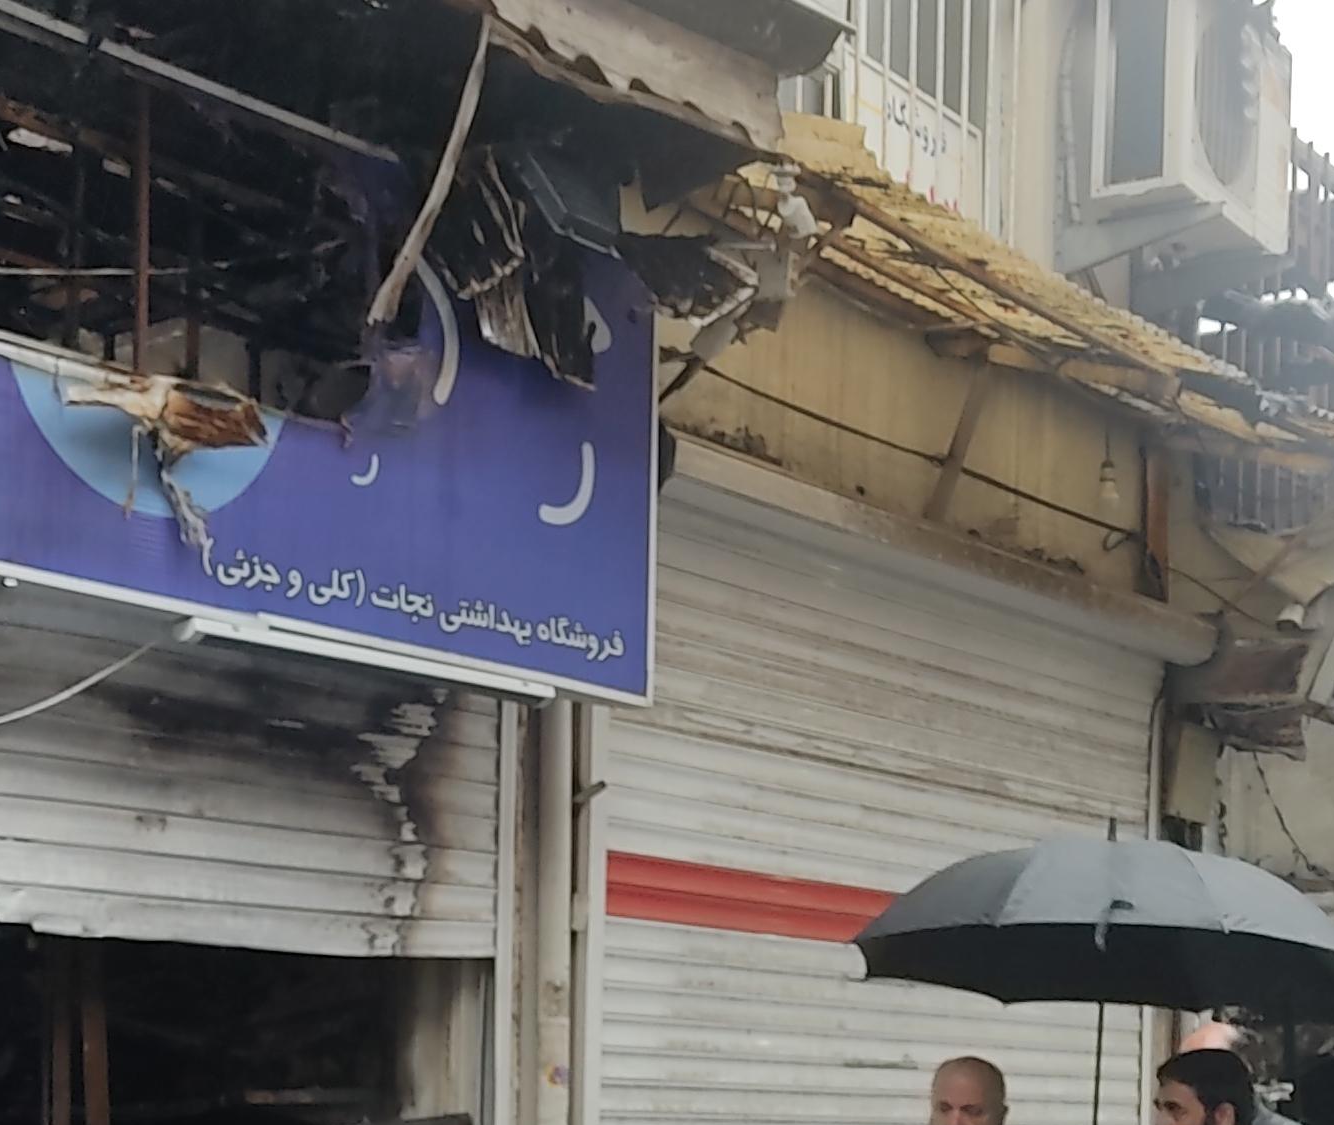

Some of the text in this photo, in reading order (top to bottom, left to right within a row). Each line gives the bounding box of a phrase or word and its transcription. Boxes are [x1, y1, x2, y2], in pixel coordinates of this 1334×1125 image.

[285, 567, 305, 600] و
[306, 567, 367, 609] (کلی
[369, 582, 435, 624] نجات
[438, 599, 534, 647] بهداشتی
[537, 615, 626, 662] فروشگاه
